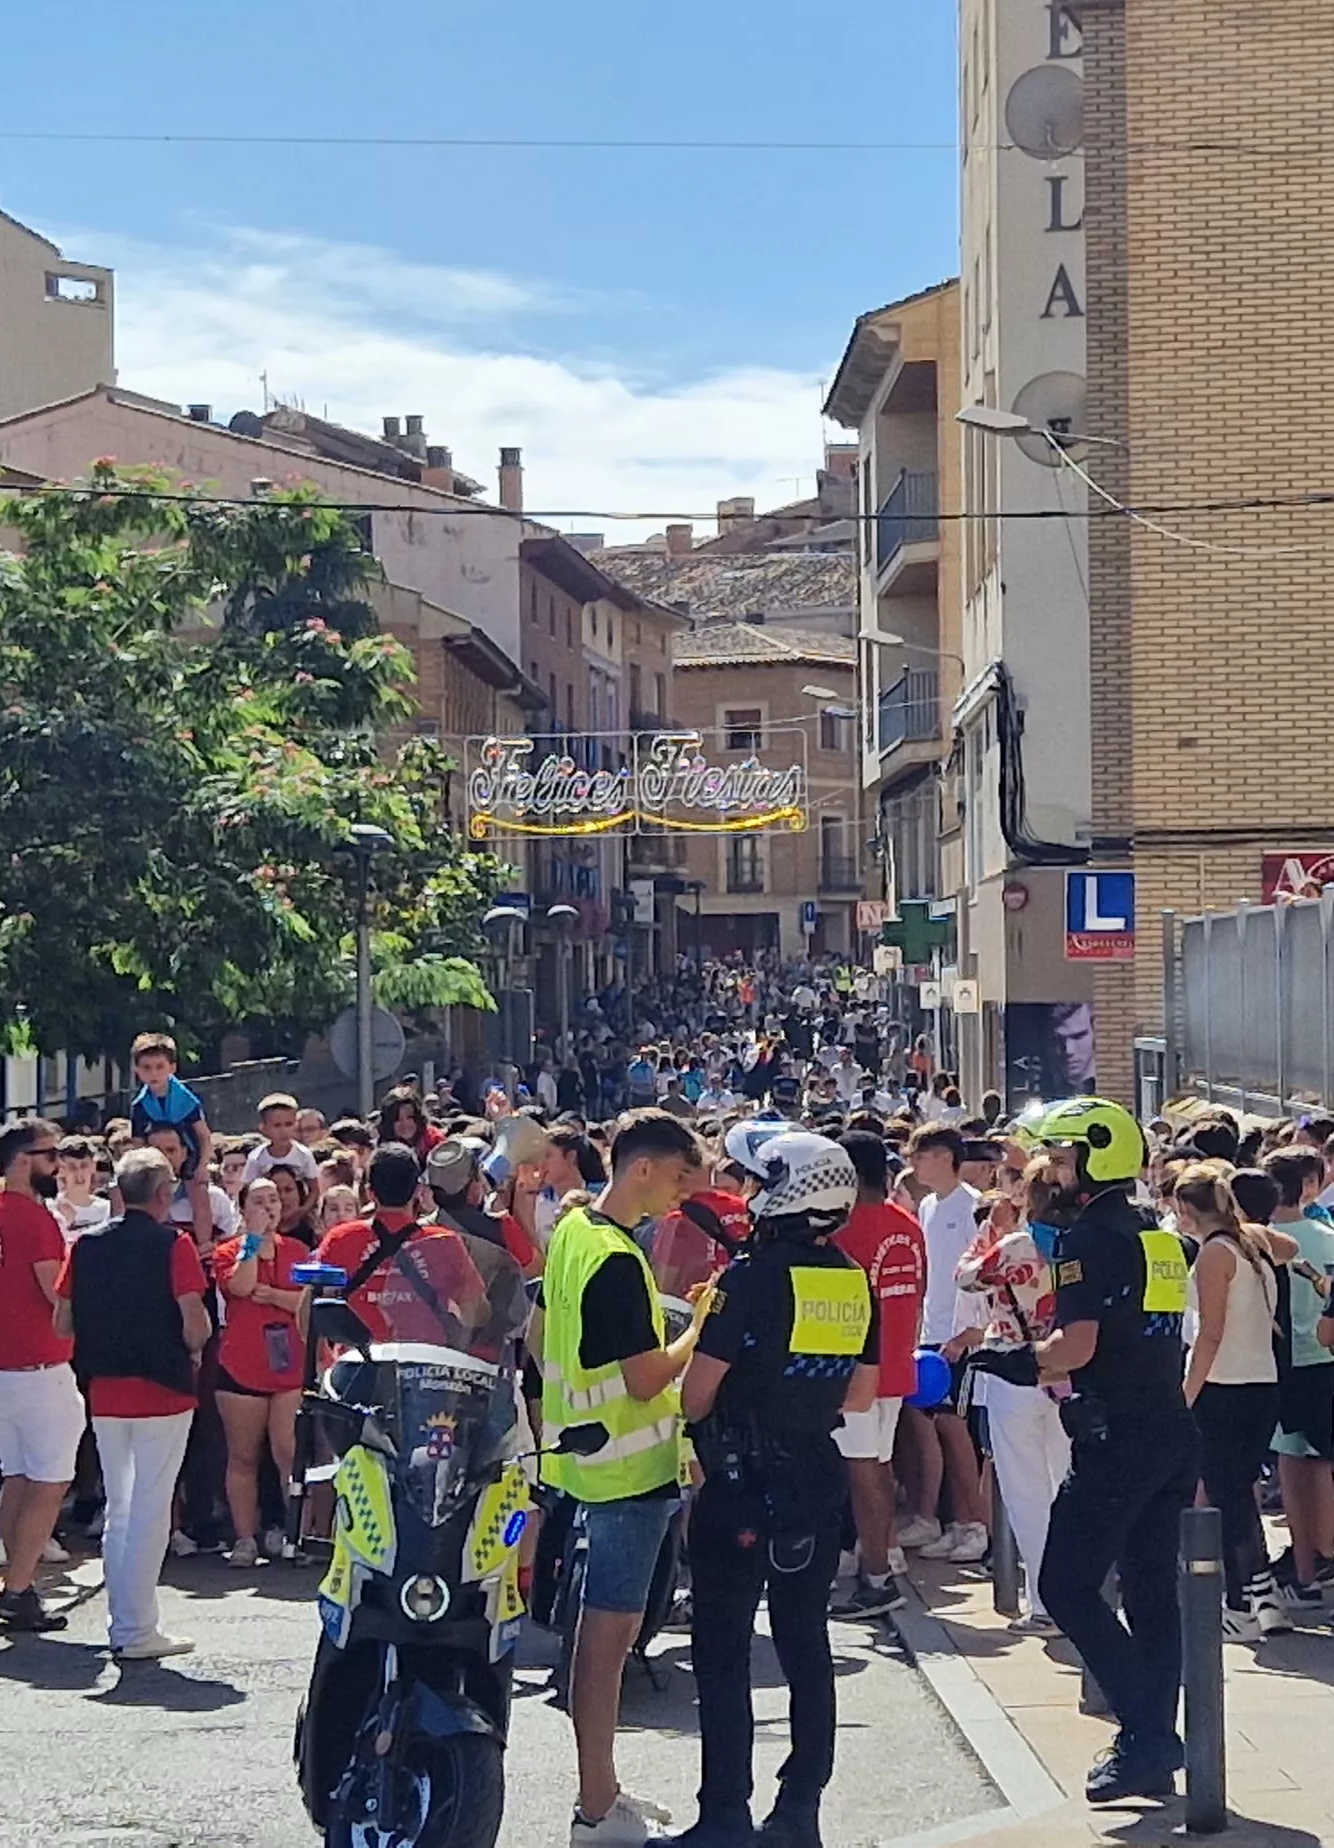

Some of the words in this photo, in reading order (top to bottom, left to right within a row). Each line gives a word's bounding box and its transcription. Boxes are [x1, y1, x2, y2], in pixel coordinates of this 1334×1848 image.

[468, 737, 630, 814] Felices
[639, 731, 805, 812] Fiestas
[1084, 876, 1126, 931] L
[801, 1294, 866, 1322] POLICÍA
[454, 1367, 497, 1390] LOCAL
